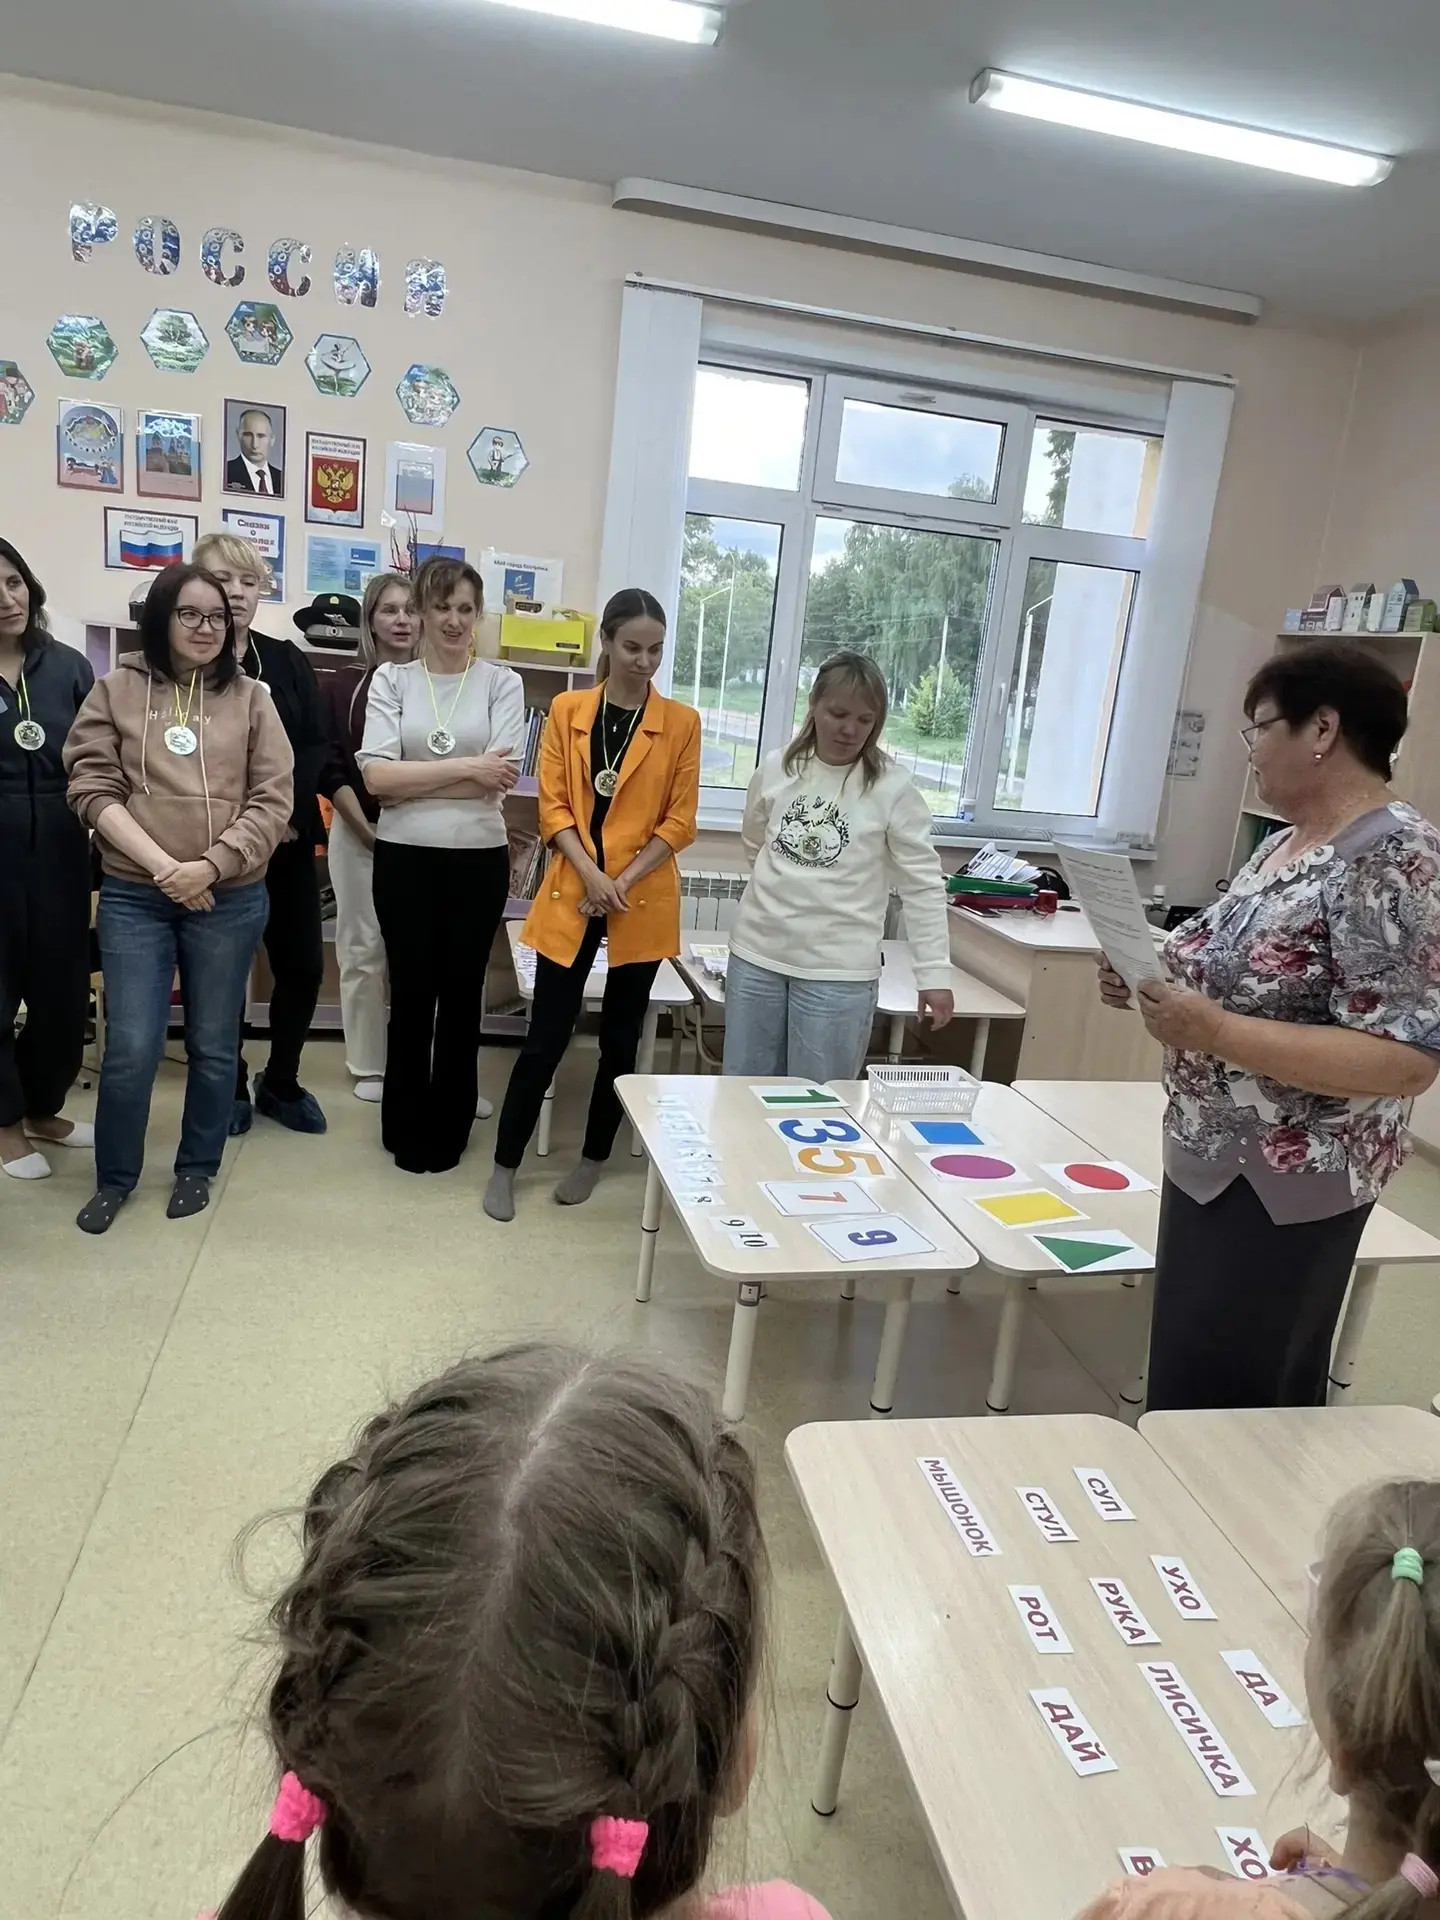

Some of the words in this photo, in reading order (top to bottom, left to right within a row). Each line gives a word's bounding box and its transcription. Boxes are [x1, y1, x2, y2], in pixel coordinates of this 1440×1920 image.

[68, 200, 449, 319] РОССИЯ
[762, 1089, 840, 1104] 1
[779, 1119, 861, 1144] 3
[798, 1147, 886, 1176] 5
[720, 1219, 745, 1228] 9
[740, 1233, 768, 1248] 10
[848, 1230, 898, 1246] 9
[925, 1460, 993, 1553] МЫШОНОК
[1025, 1491, 1068, 1537] СТУЛ
[1087, 1477, 1122, 1516] СУП
[1161, 1566, 1203, 1611] УХО
[1019, 1596, 1059, 1642] РОТ
[1098, 1583, 1148, 1642] РУКА
[1235, 1670, 1279, 1707] ДА
[1042, 1702, 1106, 1762] ДАЙ
[1147, 1666, 1241, 1791] ЛИСИЧКА
